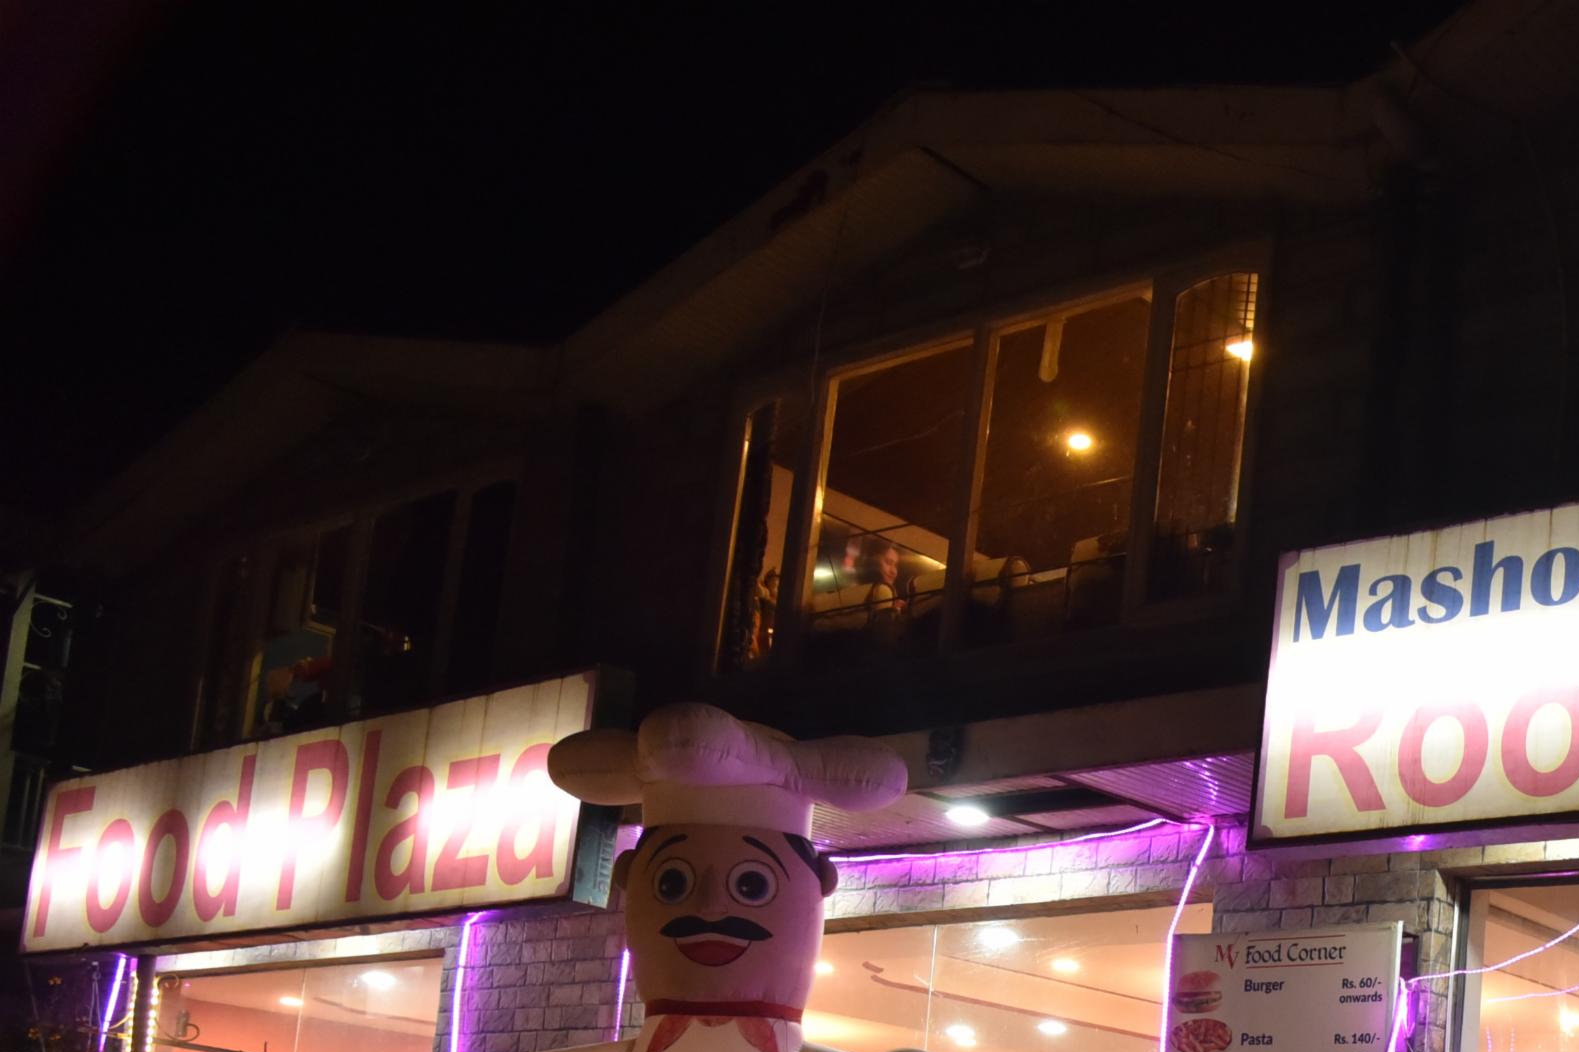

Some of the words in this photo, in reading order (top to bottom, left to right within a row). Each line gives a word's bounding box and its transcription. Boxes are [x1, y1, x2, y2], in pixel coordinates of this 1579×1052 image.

[33, 755, 257, 938] Food
[276, 730, 559, 910] Plaza
[1245, 943, 1282, 965] Food
[1287, 943, 1347, 962] Corner
[1244, 979, 1285, 994] Burger
[1342, 978, 1356, 989] Rs.
[1359, 977, 1382, 989] 60/-
[1339, 992, 1383, 1004] onwards
[1240, 1033, 1273, 1046] Pasta
[1334, 1033, 1348, 1045] Rs.
[1351, 1033, 1380, 1045] 140/-
